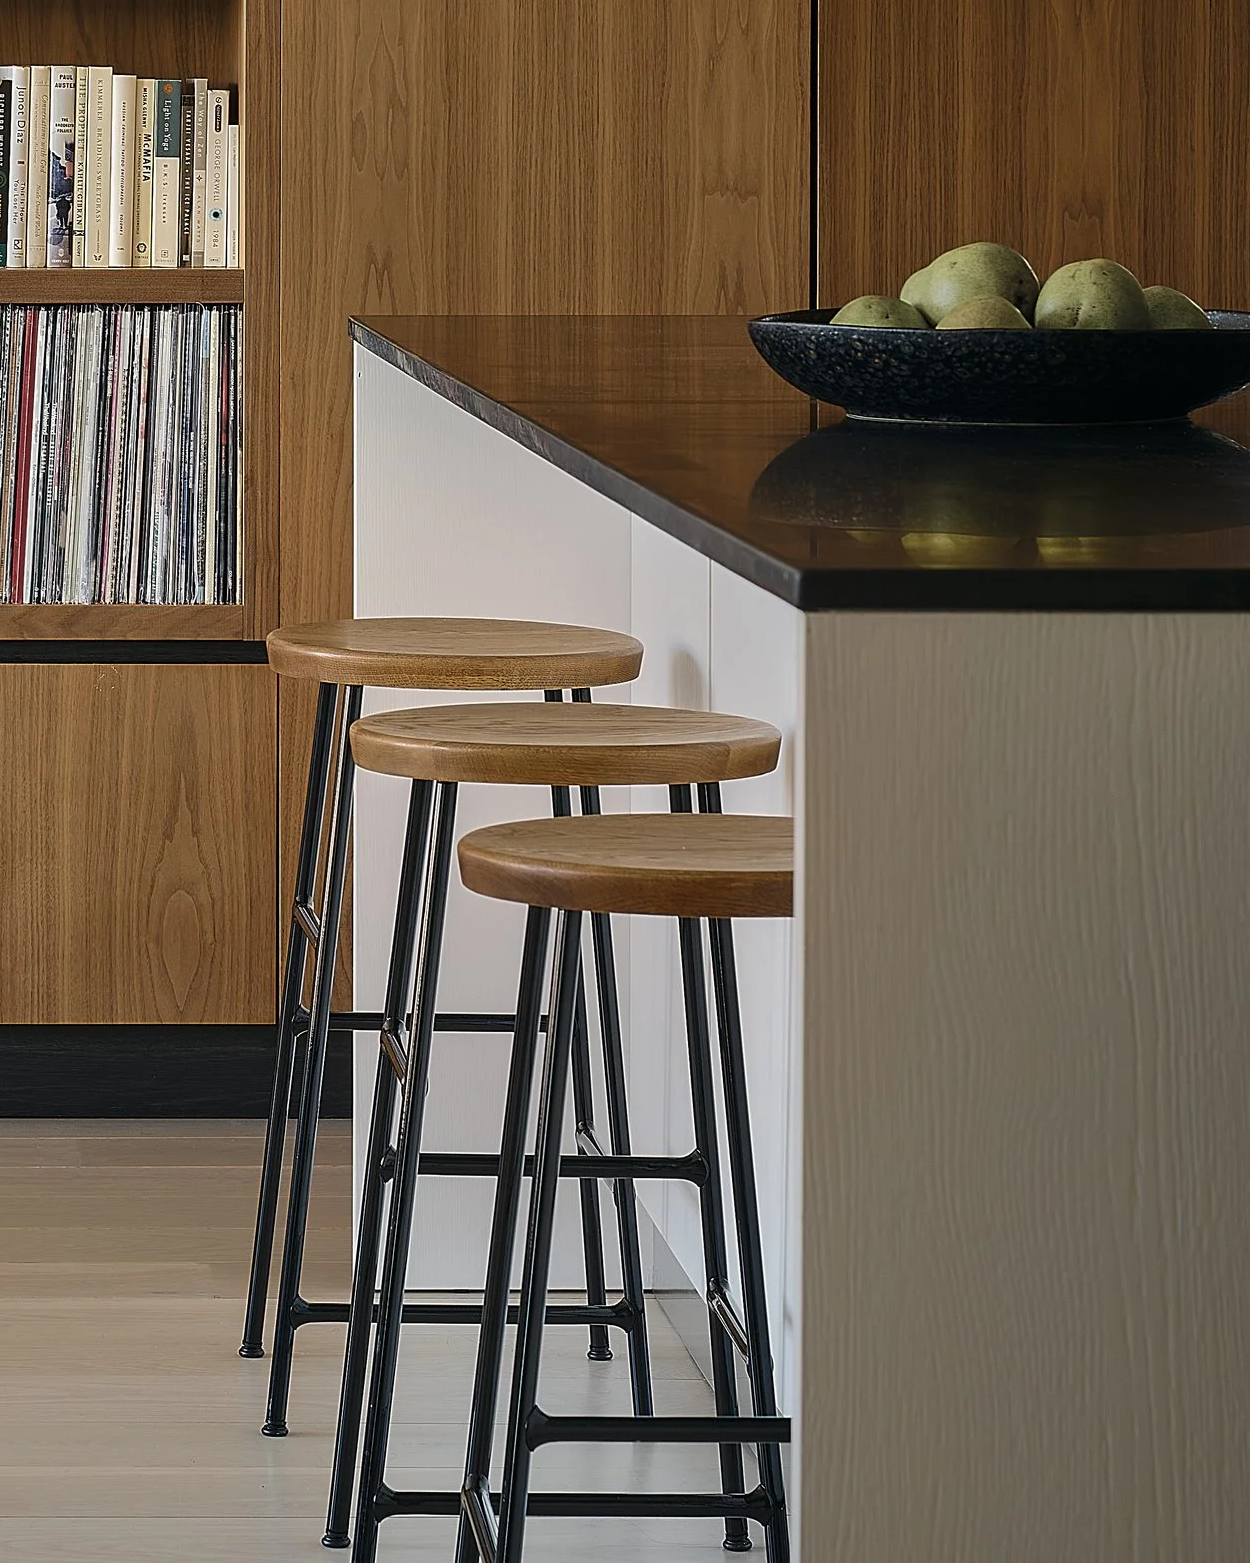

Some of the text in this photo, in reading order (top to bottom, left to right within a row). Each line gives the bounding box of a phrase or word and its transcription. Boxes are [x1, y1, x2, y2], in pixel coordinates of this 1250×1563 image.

[16, 87, 26, 115] Junot
[162, 100, 172, 151] Light on Yoga
[142, 133, 151, 181] McMAFIA
